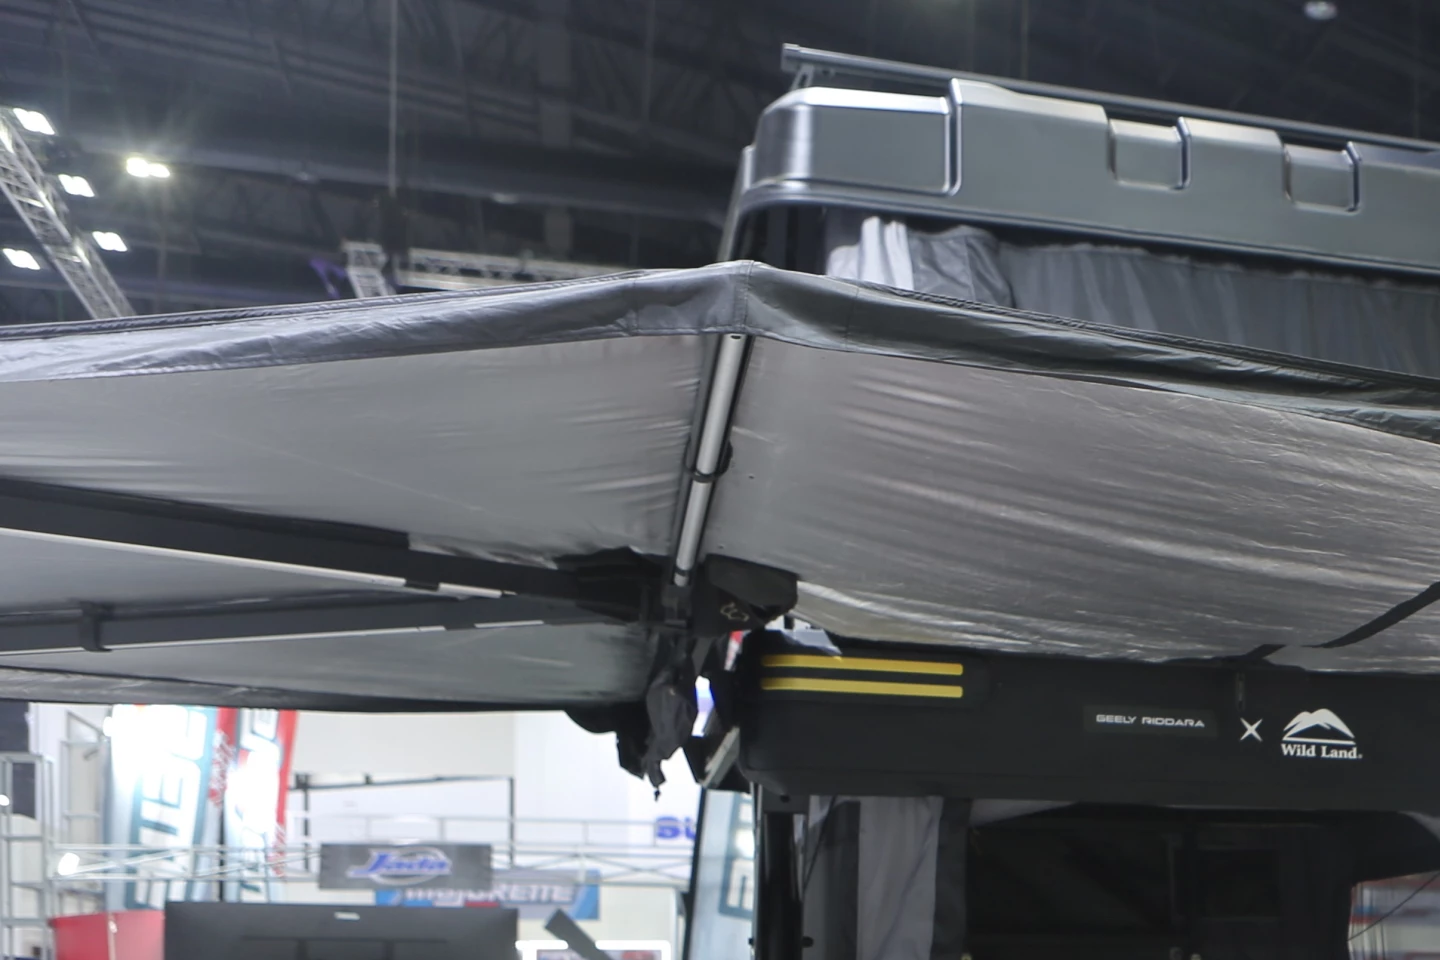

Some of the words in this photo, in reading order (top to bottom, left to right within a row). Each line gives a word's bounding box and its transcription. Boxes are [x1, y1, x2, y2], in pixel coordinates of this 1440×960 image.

[1095, 713, 1137, 725] GEELY
[1141, 716, 1205, 728] RIDDARA
[1281, 743, 1316, 758] Wild
